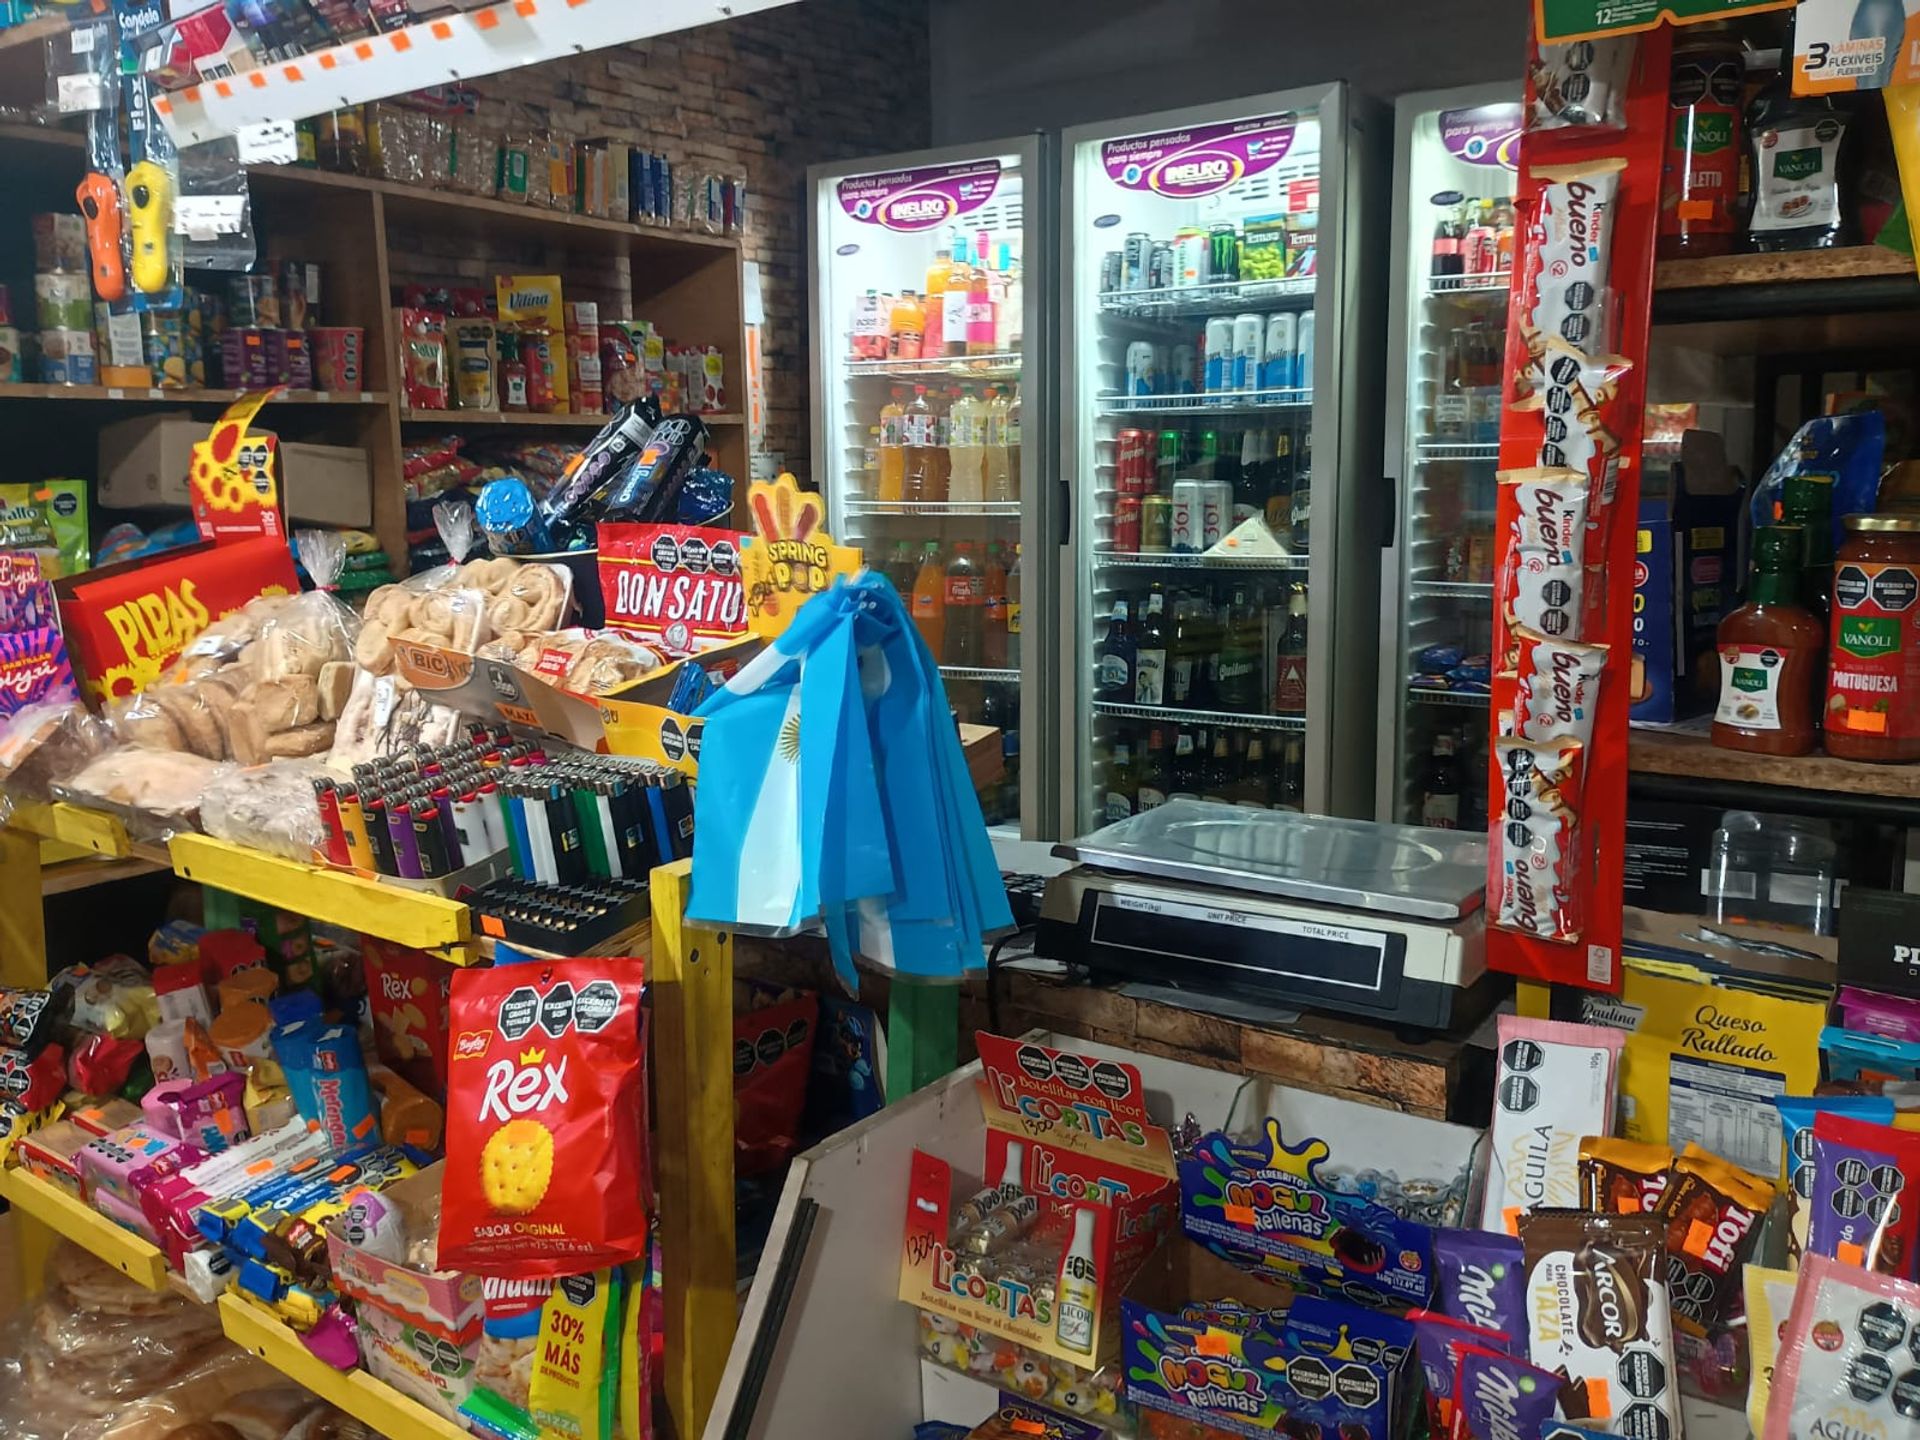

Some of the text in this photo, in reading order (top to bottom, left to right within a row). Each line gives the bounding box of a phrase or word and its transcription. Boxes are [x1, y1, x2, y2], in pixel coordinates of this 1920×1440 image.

[118, 8, 160, 29] Candela
[1804, 42, 1830, 70] 3
[131, 78, 145, 132] Flex
[1106, 150, 1163, 168] para siempre
[1107, 133, 1191, 155] Productos pensados
[841, 173, 913, 191] Productos pensados
[1778, 161, 1816, 174] VANOLI
[1567, 181, 1596, 268] bueno
[1589, 202, 1606, 245] Kinder
[1534, 488, 1564, 567] bueno
[1562, 509, 1575, 549] Kinder
[769, 540, 828, 569] SPRING
[615, 570, 669, 619] DON
[103, 578, 211, 664] PIPAS
[1843, 632, 1892, 648] VANOLI
[413, 653, 443, 674] BIC
[1552, 651, 1580, 723] bueno
[1833, 670, 1898, 693] PORTUGUESA
[1503, 876, 1515, 909] Kinder
[1512, 859, 1538, 932] bueno
[1207, 911, 1247, 926] UNIT PRICE
[1302, 925, 1350, 941] TOTAL PRICE
[381, 971, 413, 1000] Rex
[1582, 1002, 1637, 1027] Paulina
[1694, 1004, 1767, 1033] Queso
[1680, 1027, 1778, 1063] Rallado
[478, 1054, 570, 1123] Rex
[1018, 1075, 1143, 1117] Botellitas con licor
[1021, 1118, 1055, 1137] 1300
[1256, 1169, 1309, 1189] CEREBRITOS
[1525, 1123, 1553, 1211] AGUILA
[1228, 1181, 1329, 1222] MOGUL
[474, 1223, 512, 1238] SABOR
[1254, 1212, 1323, 1236] Rellenas
[1702, 1205, 1755, 1273] Tofi
[906, 1231, 936, 1268] 1300
[1544, 1263, 1554, 1282] PARA
[1457, 1263, 1502, 1331] Mil
[1554, 1264, 1575, 1336] CHOCOLATE
[1592, 1247, 1623, 1338] ARCOR
[551, 1309, 585, 1345] 30%
[921, 1291, 957, 1312] Botellitas
[958, 1306, 973, 1318] con
[974, 1309, 993, 1324] licor
[1003, 1319, 1043, 1344] chocolate
[1061, 1304, 1092, 1323] LICOR
[1534, 1283, 1562, 1344] TAZA
[544, 1341, 581, 1375] MÁS
[1162, 1357, 1267, 1400] MOGUL
[1186, 1390, 1259, 1414] Rellenas
